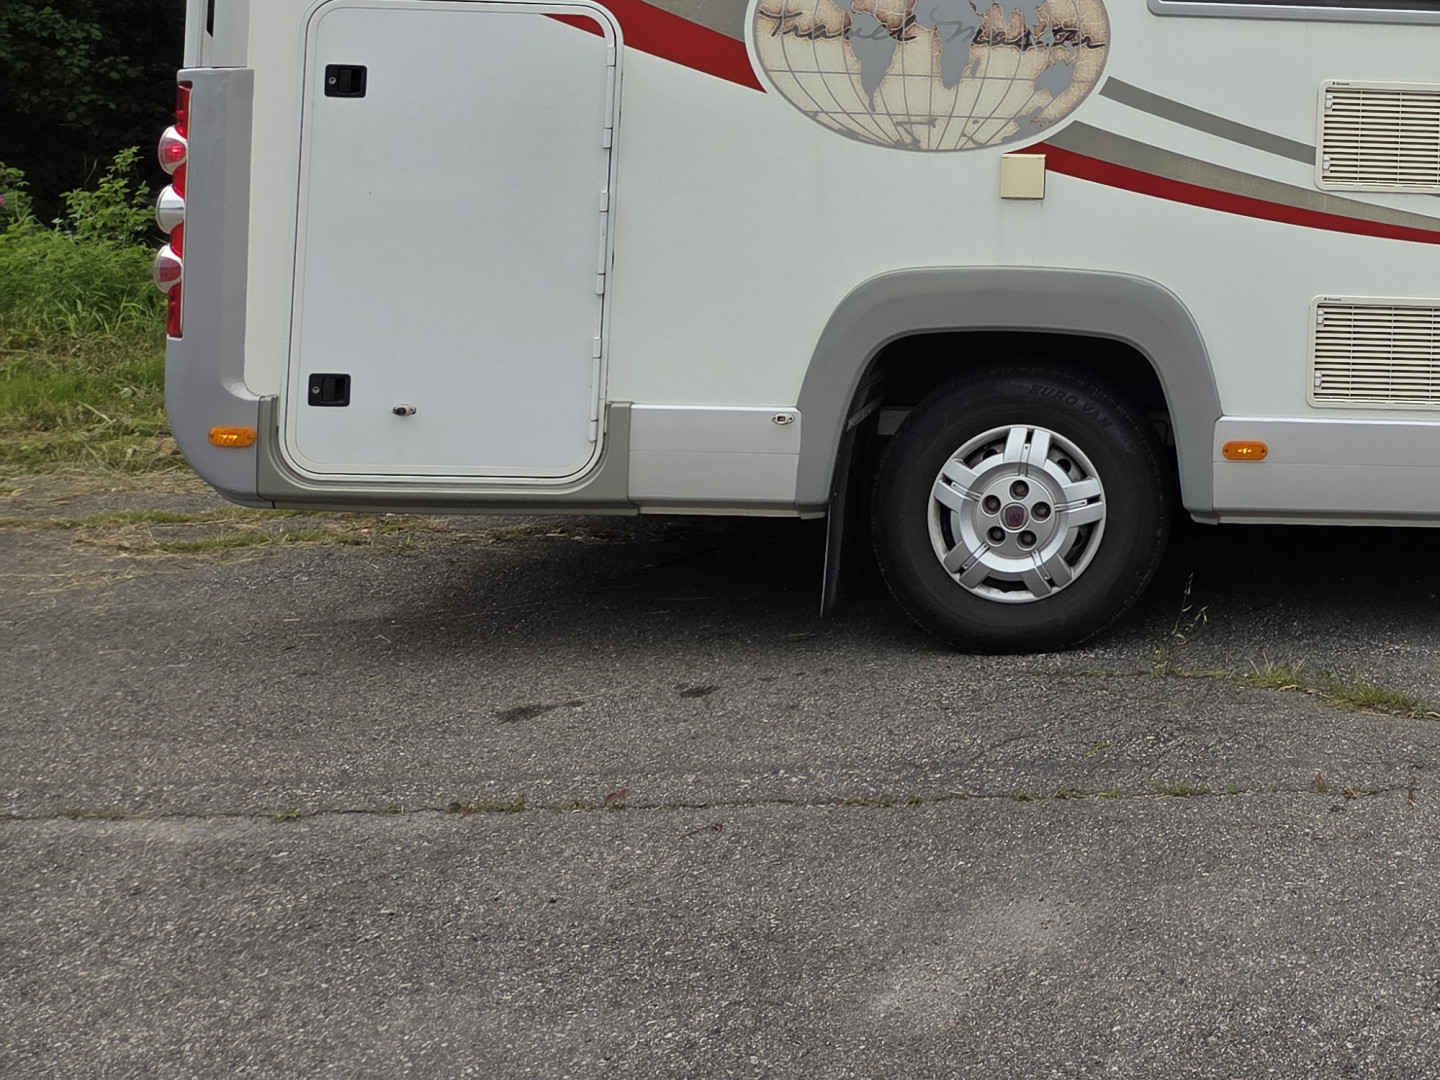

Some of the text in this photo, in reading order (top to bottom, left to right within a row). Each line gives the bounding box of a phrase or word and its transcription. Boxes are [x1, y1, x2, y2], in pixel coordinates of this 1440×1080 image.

[759, 9, 917, 41] Travel
[1028, 384, 1113, 428] EURO VAN
